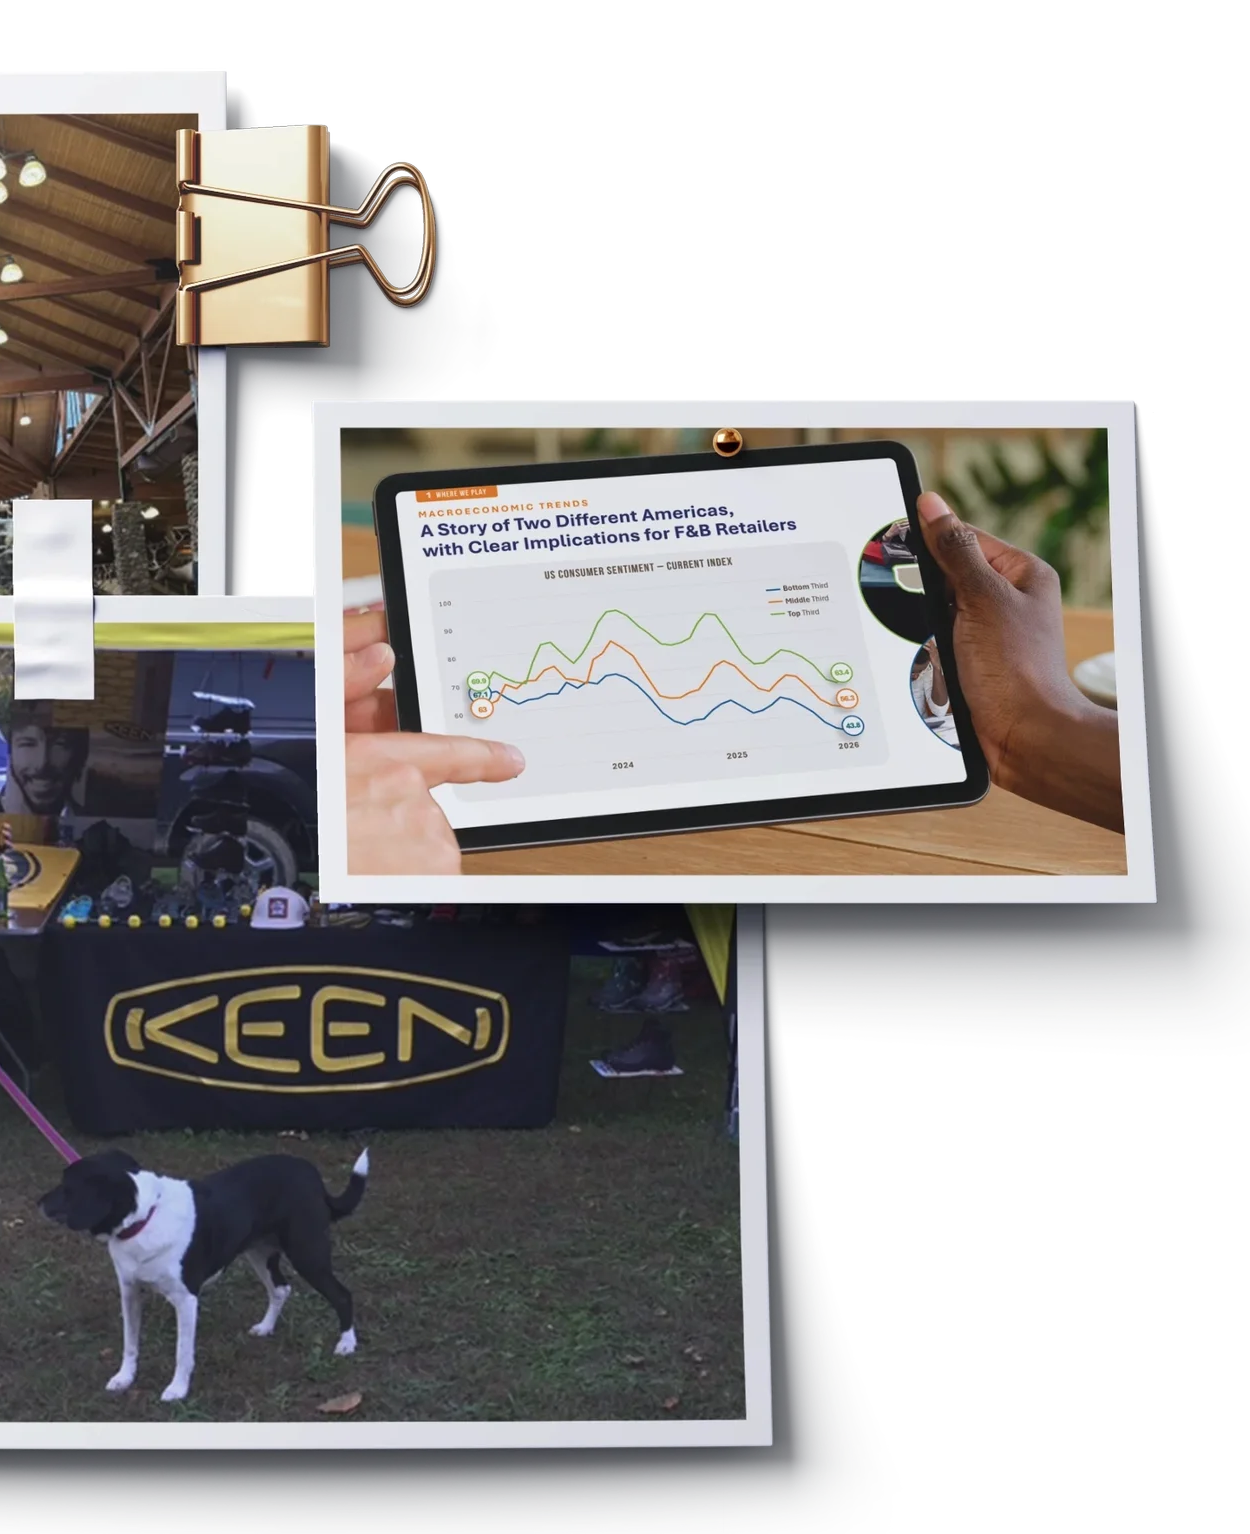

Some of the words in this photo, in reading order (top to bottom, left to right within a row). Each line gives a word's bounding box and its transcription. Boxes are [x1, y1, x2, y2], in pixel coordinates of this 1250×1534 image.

[436, 490, 458, 499] WHERE
[459, 489, 470, 497] WE
[470, 488, 487, 497] PLAY
[418, 503, 534, 518] MACROECONOMIC
[538, 499, 589, 510] TRENDS
[420, 524, 434, 538] A
[438, 522, 488, 537] Story
[492, 518, 510, 533] of
[514, 516, 552, 531] Two
[555, 510, 639, 528] Different
[642, 504, 734, 522] Americas,
[422, 542, 464, 558] with
[468, 539, 519, 554] Clear
[524, 532, 641, 552] Implications
[644, 528, 670, 542] for
[674, 524, 712, 539] F&B
[715, 519, 797, 536] Retailers
[544, 570, 556, 580] US
[558, 566, 605, 579] CONSUMER
[606, 562, 655, 575] SENTIMENT
[666, 559, 705, 571] CURRENT
[706, 556, 733, 568] INDEX
[782, 584, 810, 592] Bottom
[438, 600, 452, 608] 100
[785, 596, 810, 604] Middle
[788, 610, 801, 618] Top
[838, 742, 860, 750] 2026
[726, 751, 748, 760] 2025
[612, 761, 634, 770] 2024
[126, 985, 491, 1073] KEEN
